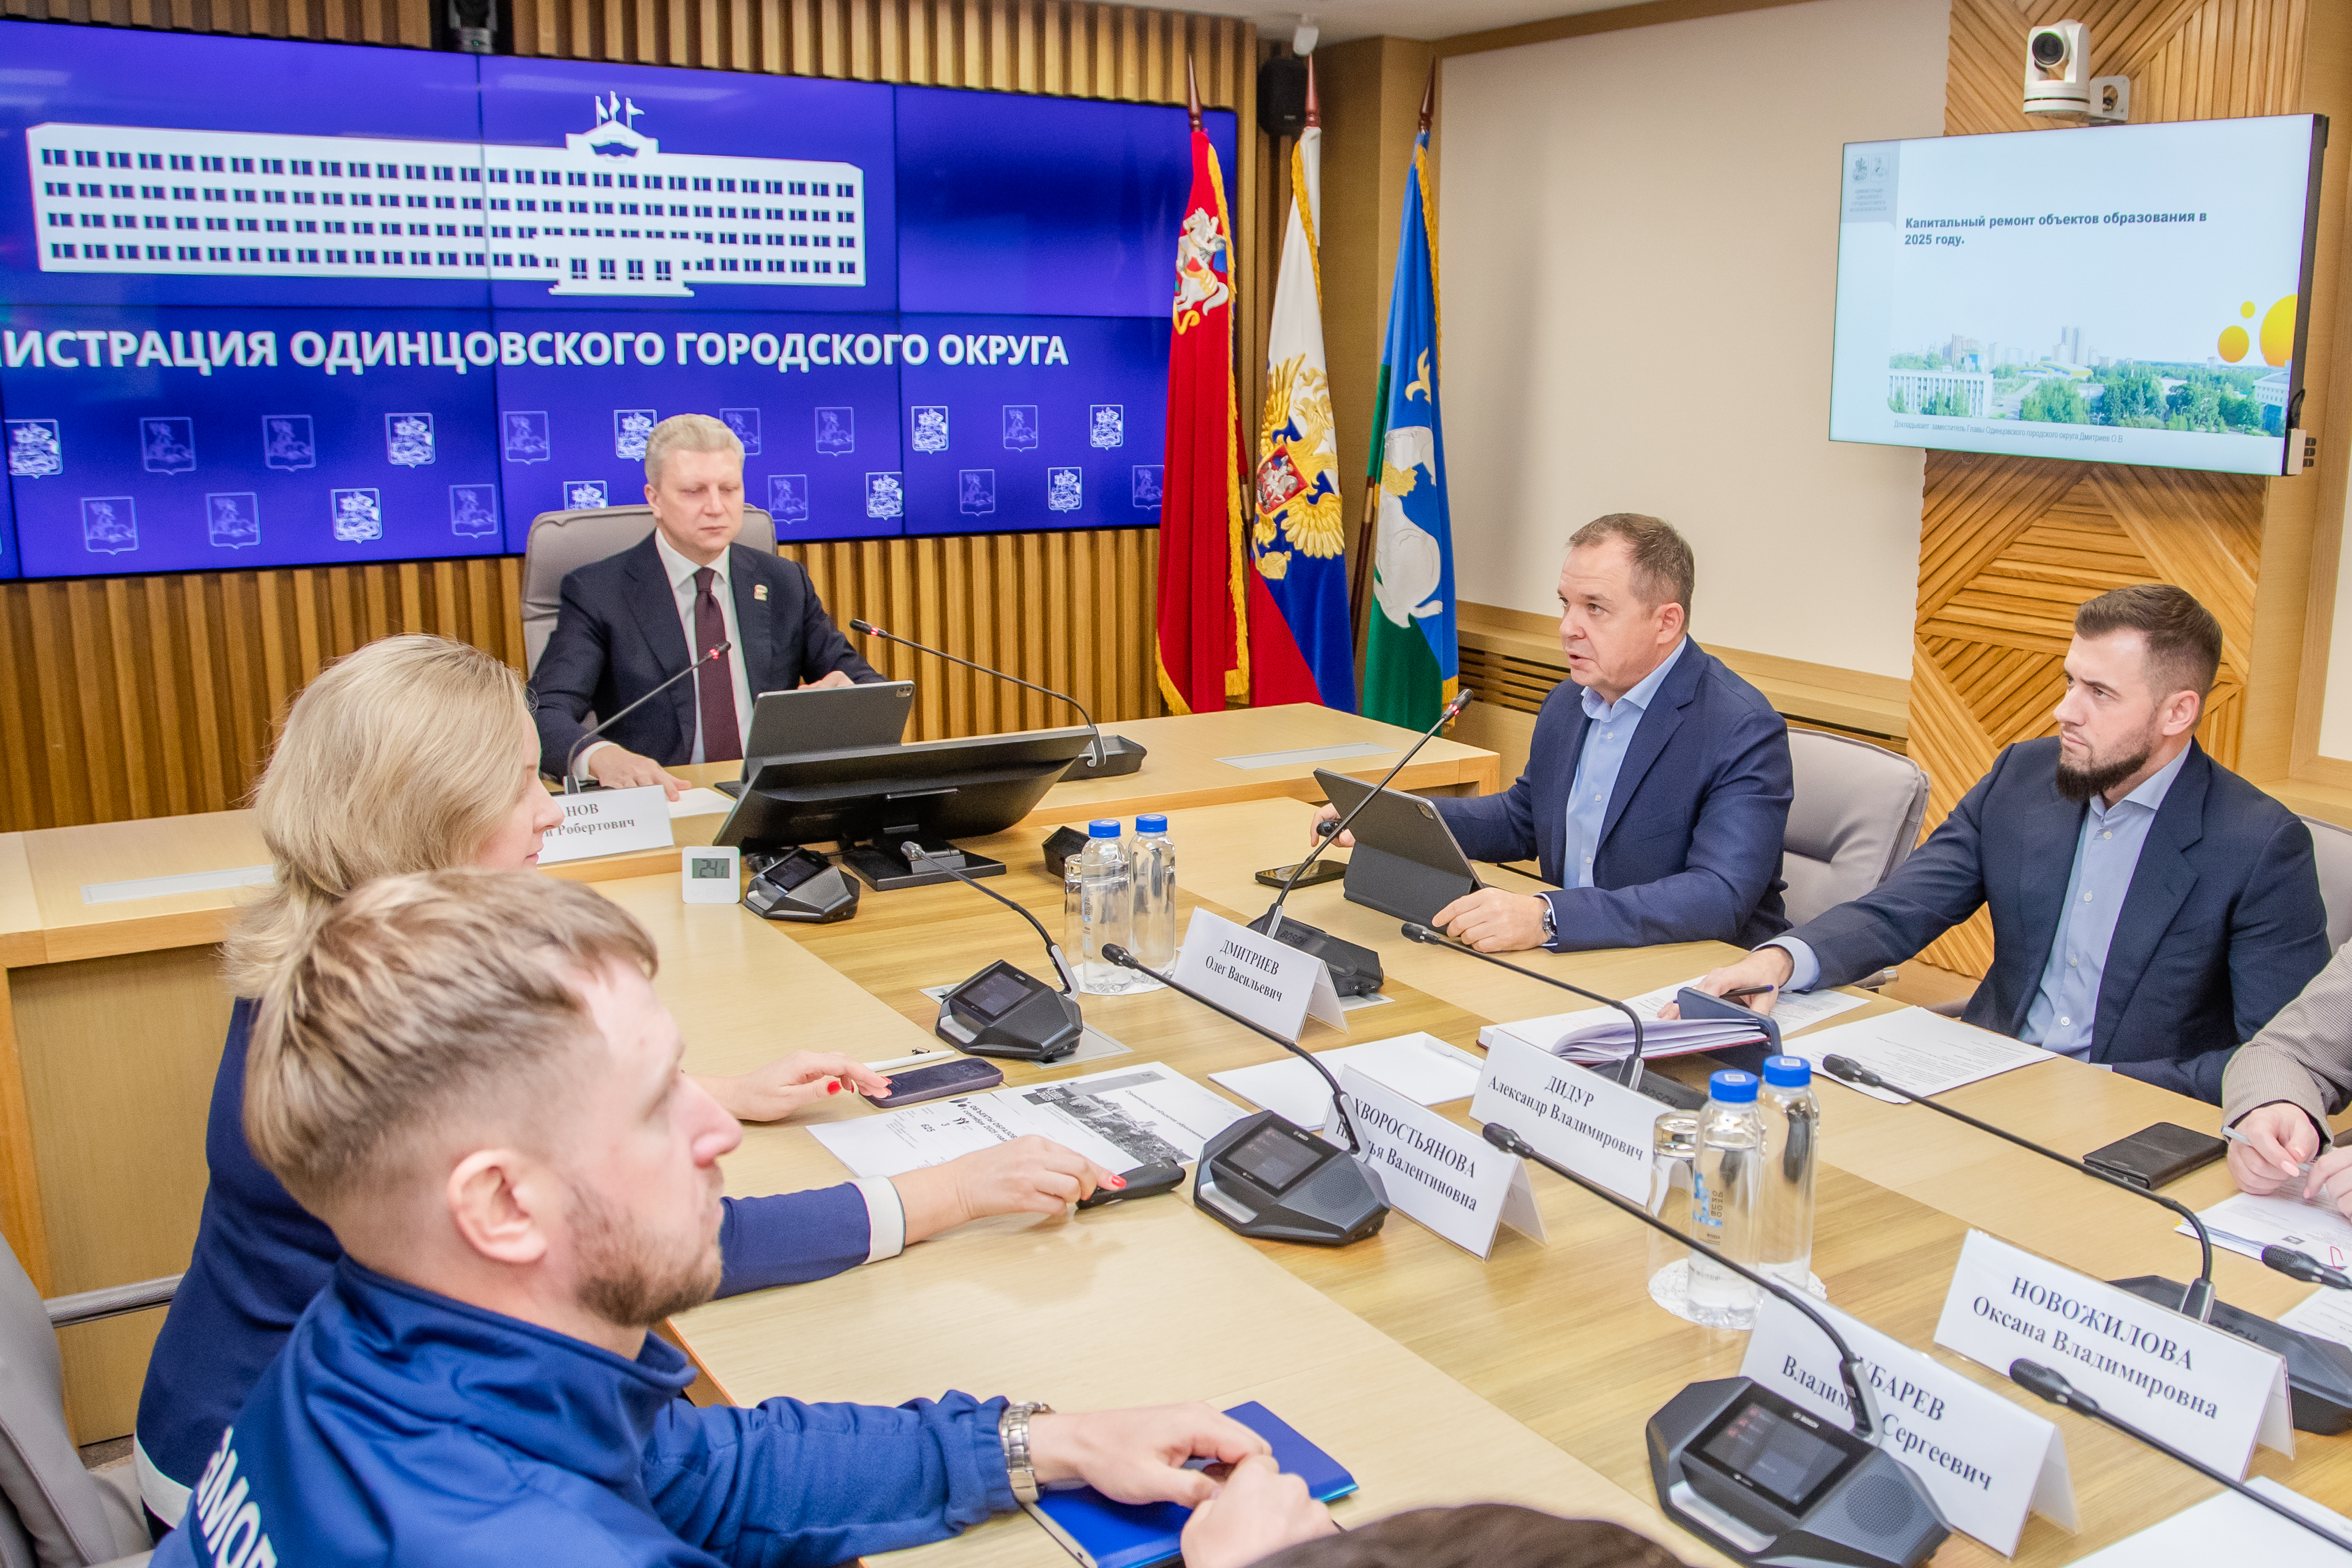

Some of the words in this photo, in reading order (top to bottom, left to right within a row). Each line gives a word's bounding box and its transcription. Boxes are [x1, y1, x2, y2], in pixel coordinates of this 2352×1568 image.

[1906, 215, 1985, 228] Капитальный
[1990, 216, 2035, 228] ремонт
[2039, 213, 2099, 225] объектов
[2103, 212, 2195, 226] образования
[2200, 213, 2207, 221] в
[1905, 234, 1932, 245] 2025
[1936, 235, 1965, 247] году.
[290, 331, 665, 375] ОДИНЦОВСКОГО
[676, 331, 929, 373] ГОРОДСКОГО
[938, 333, 1070, 366] ОКРУГА
[558, 819, 635, 835] Робертович
[565, 803, 599, 817] НОВ
[1219, 939, 1280, 975] ДМИТРИЕВ
[1280, 930, 1308, 946] BOSCH
[1205, 956, 1227, 975] Олег
[1227, 965, 1282, 1002] Васильевич
[1544, 1075, 1595, 1107] ДИДУР
[920, 1123, 936, 1133] 625
[1488, 1075, 1547, 1117] Александр
[1549, 1103, 1644, 1161] Владимирович
[1355, 1098, 1476, 1179] ХВОРОСТЬЯНОВА
[1386, 1148, 1477, 1212] Валентиновна
[2010, 1276, 2193, 1372] НОВОЖИЛОВА
[1973, 1296, 2047, 1343] Оксана
[2051, 1329, 2219, 1420] Владимировна
[1882, 1413, 1993, 1492] Сергеевич
